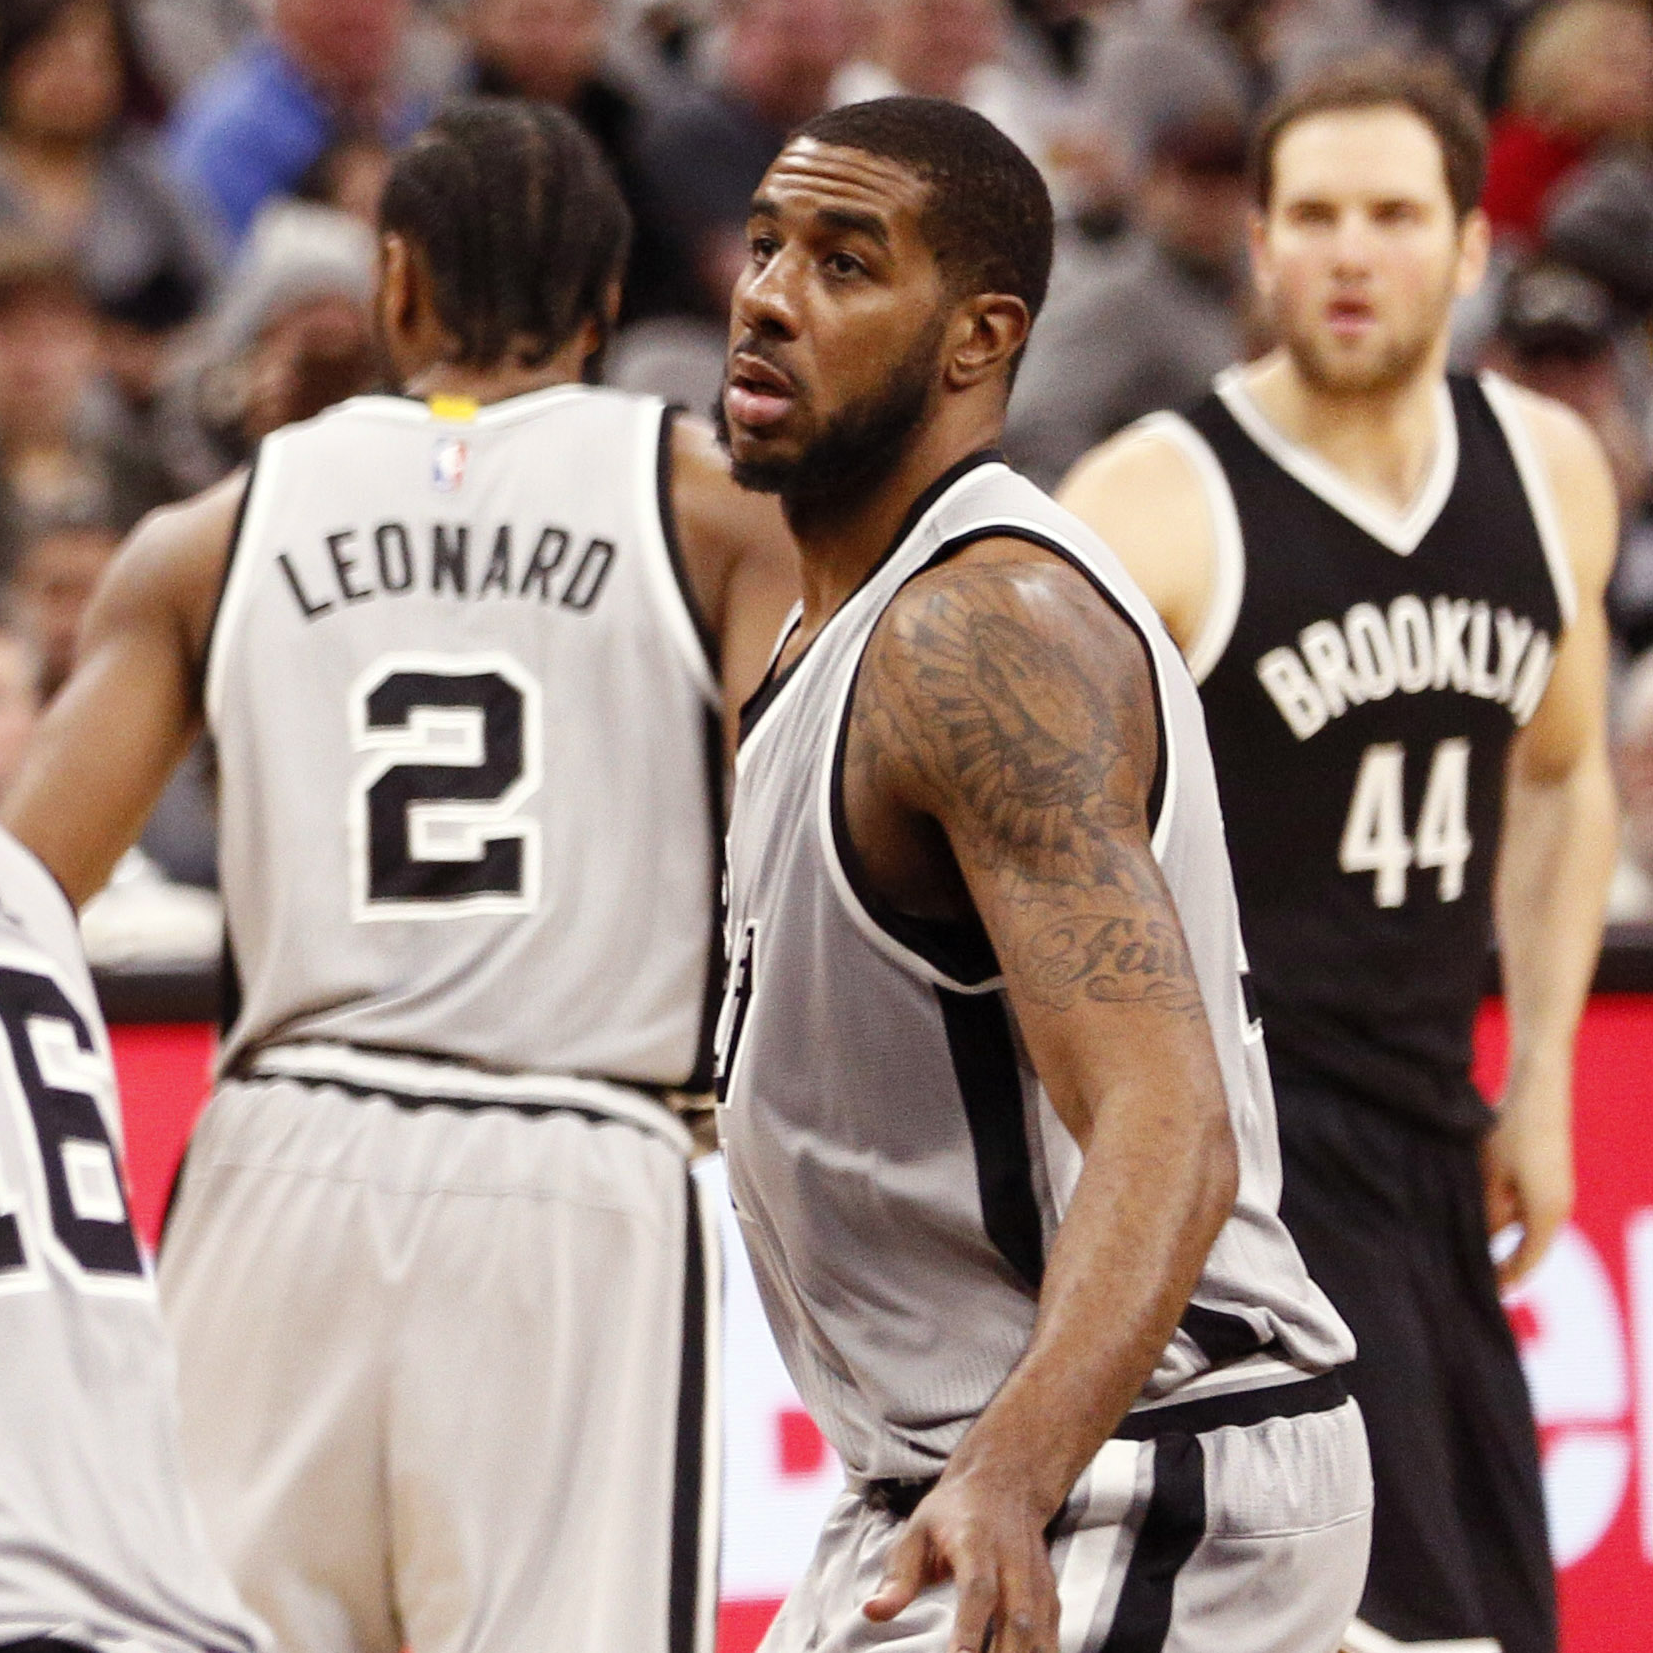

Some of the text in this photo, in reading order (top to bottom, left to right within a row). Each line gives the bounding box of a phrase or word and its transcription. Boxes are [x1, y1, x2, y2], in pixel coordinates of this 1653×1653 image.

[277, 520, 617, 622] LEONARD
[349, 650, 543, 922] 2
[1339, 737, 1474, 909] 44
